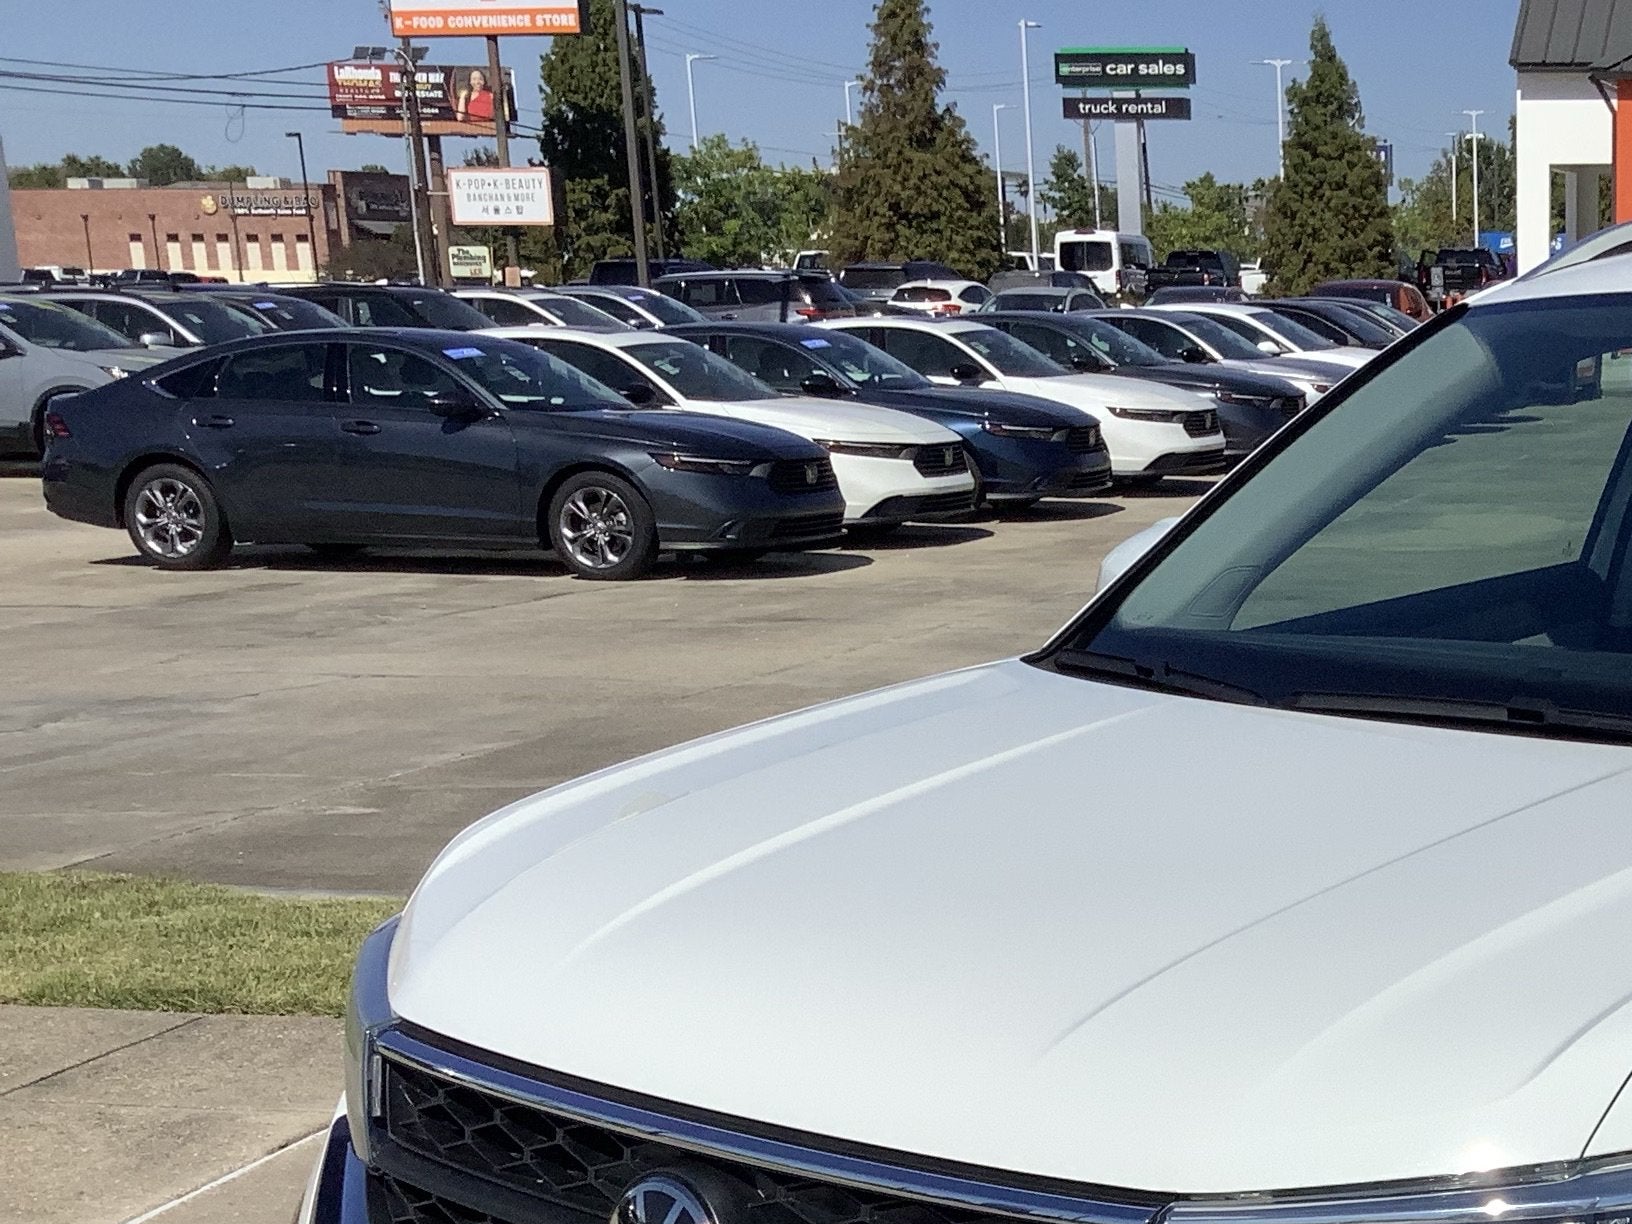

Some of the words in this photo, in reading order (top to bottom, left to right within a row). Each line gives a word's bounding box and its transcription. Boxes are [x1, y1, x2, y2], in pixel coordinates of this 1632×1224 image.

[395, 16, 444, 29] K-FOOD
[447, 15, 532, 28] CONVENIENCE
[535, 14, 576, 27] STORE
[1060, 63, 1101, 74] enterprise
[1106, 63, 1135, 75] car
[1138, 60, 1185, 75] sales
[1079, 101, 1118, 114] truck
[1122, 101, 1166, 114] rental
[466, 193, 505, 202] BANCHAN
[513, 193, 535, 202] MORE
